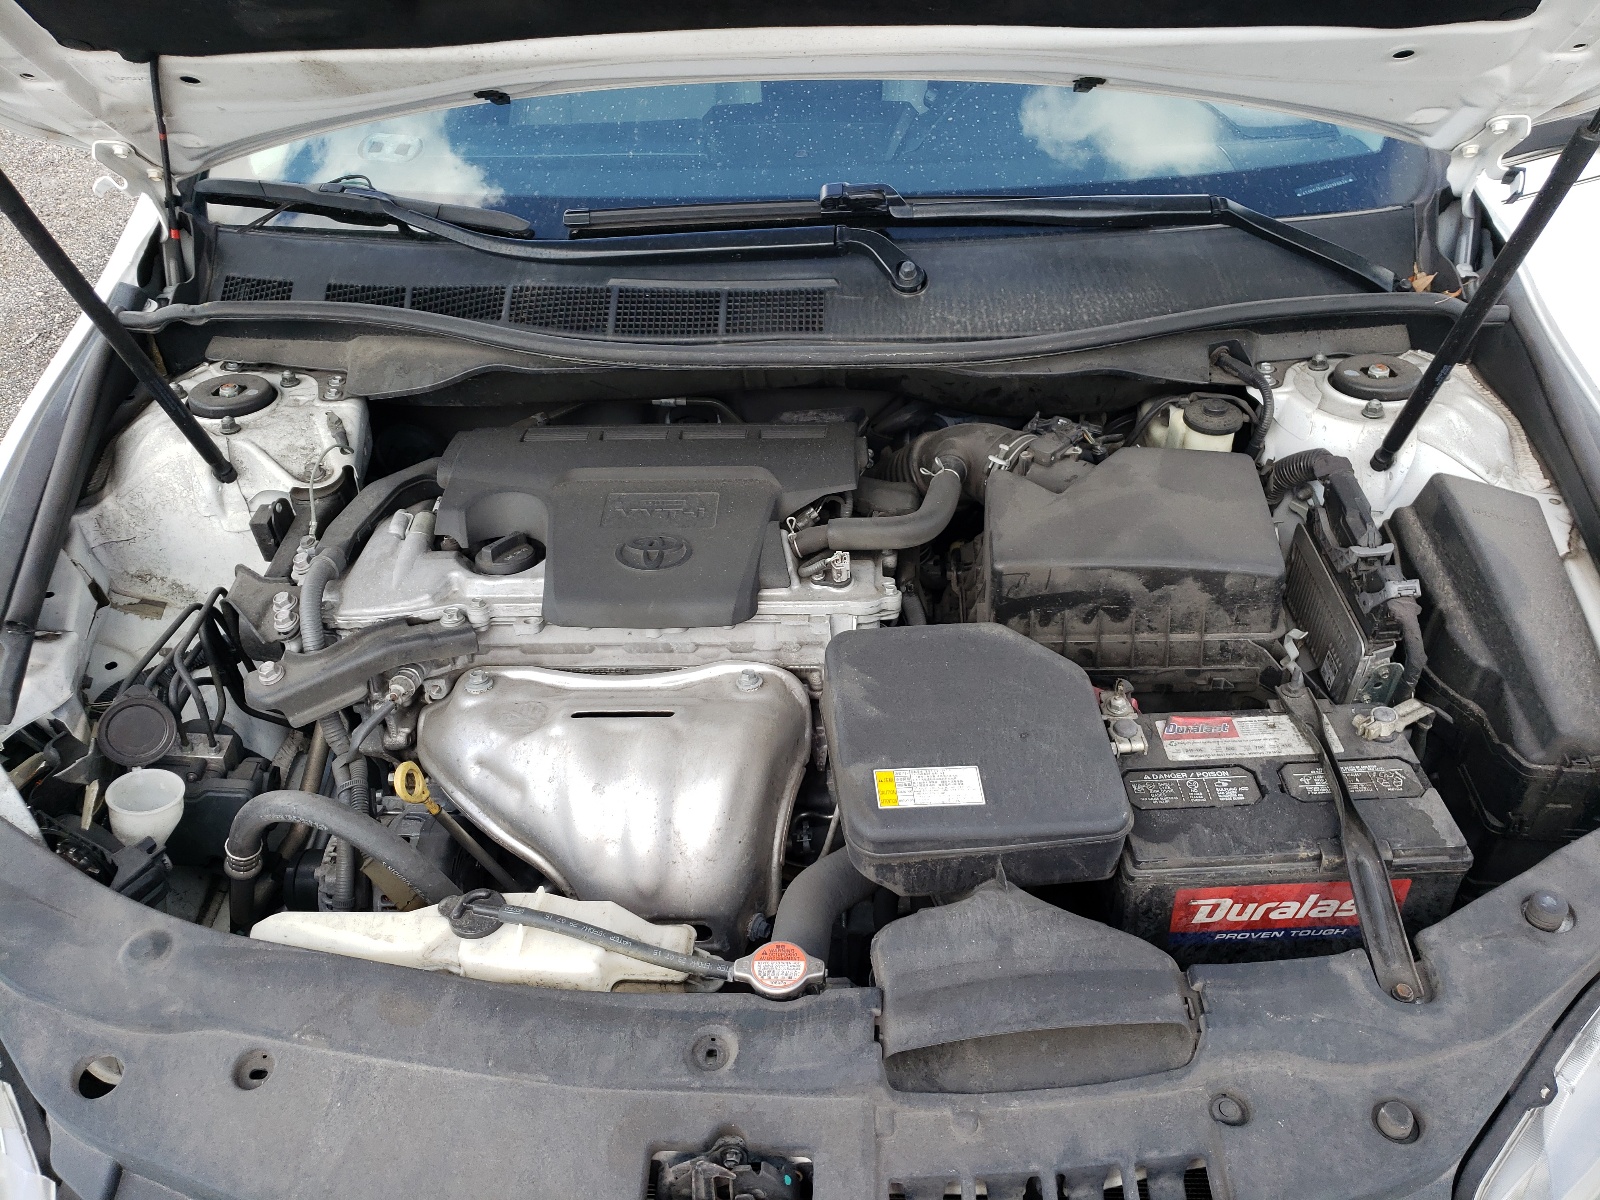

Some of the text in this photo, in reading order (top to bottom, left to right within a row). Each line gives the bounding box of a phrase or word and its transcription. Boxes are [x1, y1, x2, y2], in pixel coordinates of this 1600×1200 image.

[1165, 722, 1229, 734] Duralast
[1188, 894, 1357, 923] Duralas
[1215, 928, 1348, 940] PROVEN TOUGH
